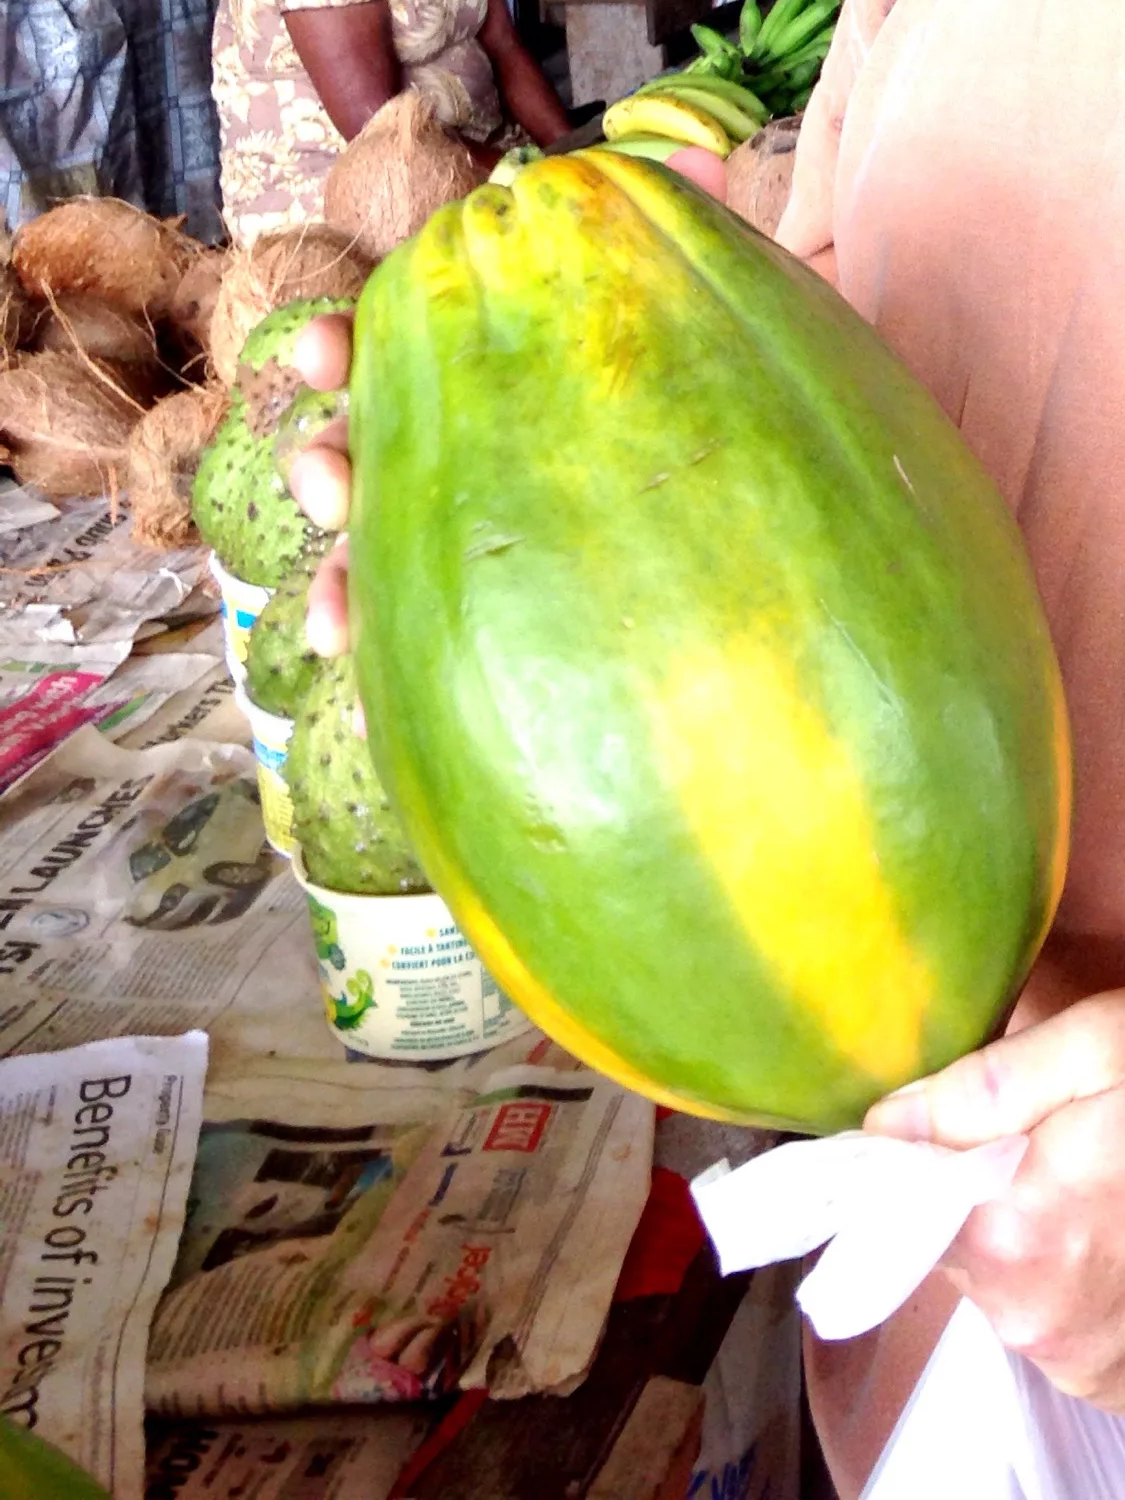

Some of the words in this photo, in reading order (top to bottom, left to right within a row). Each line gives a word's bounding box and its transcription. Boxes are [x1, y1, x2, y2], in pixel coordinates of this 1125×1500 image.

[10, 773, 156, 894] LAUNCHES
[53, 1073, 131, 1217] Benefits
[41, 1226, 98, 1266] of
